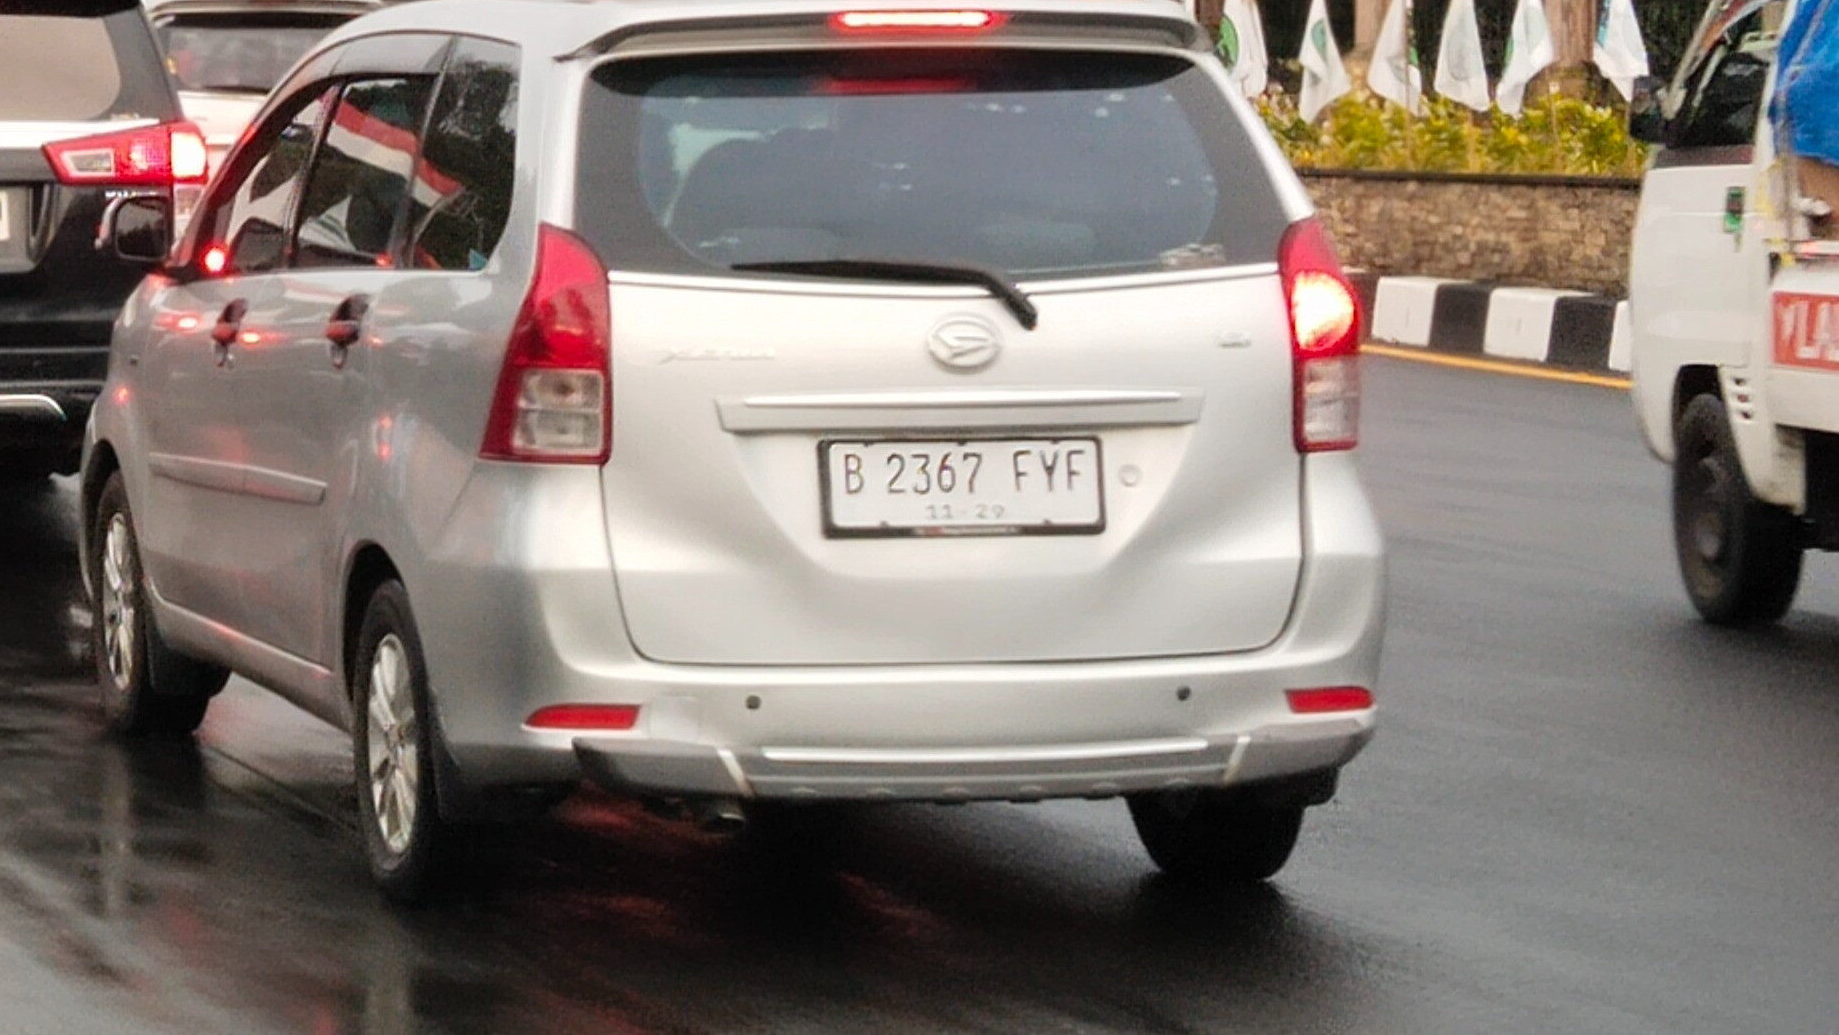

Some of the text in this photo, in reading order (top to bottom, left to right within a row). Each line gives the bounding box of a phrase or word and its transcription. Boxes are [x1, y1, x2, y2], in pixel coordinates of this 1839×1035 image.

[844, 449, 1086, 495] B 2367 FYF
